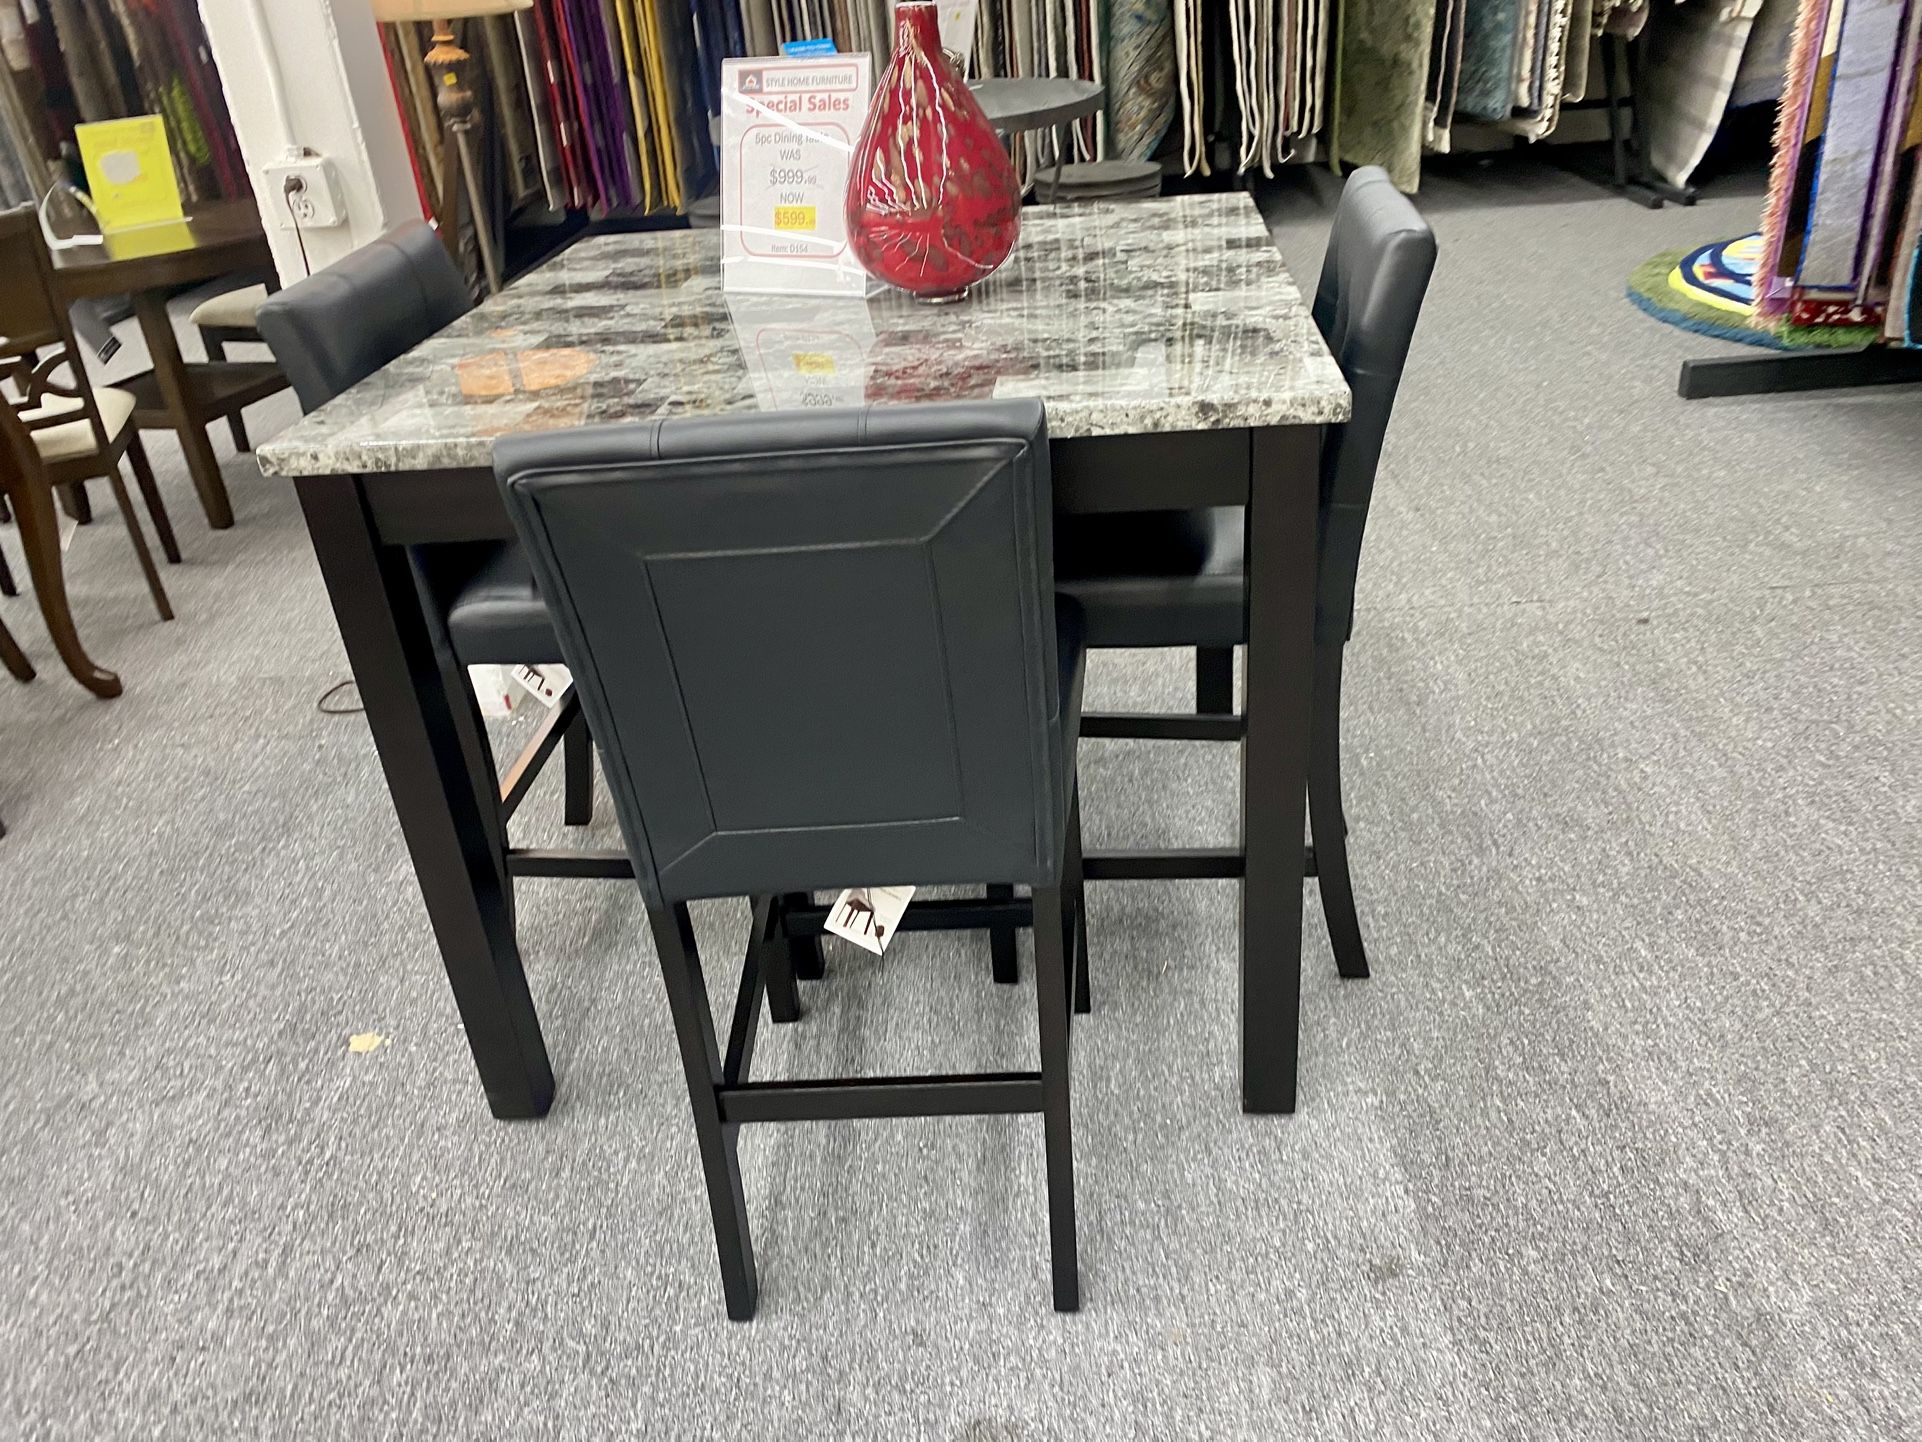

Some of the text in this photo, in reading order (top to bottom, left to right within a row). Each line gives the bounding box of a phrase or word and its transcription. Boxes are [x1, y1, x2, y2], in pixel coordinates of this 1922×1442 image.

[766, 77, 786, 88] STYLE
[787, 76, 810, 87] HOME
[811, 74, 853, 86] FURNITURE
[807, 93, 850, 112] Sales
[774, 131, 803, 146] Dining
[780, 148, 801, 161] WAS
[780, 192, 805, 204] NOW
